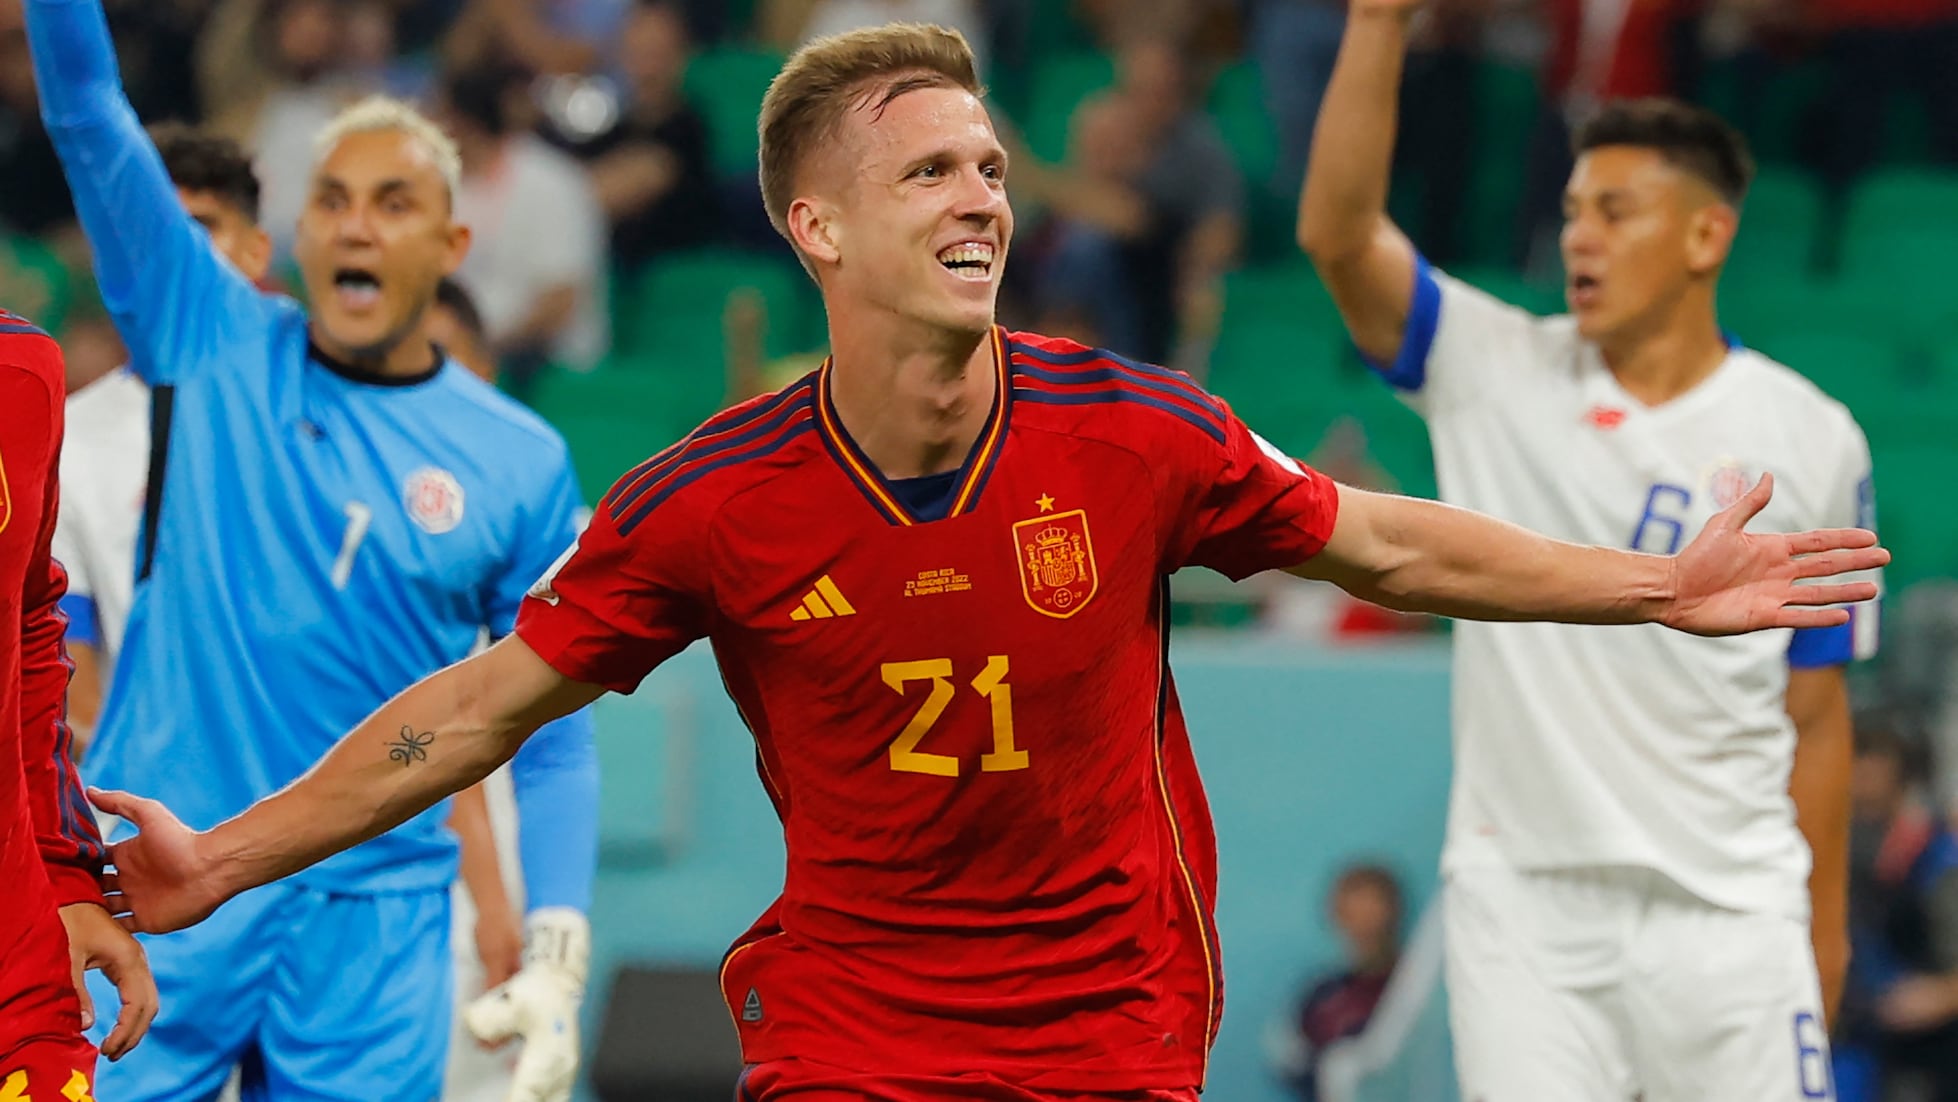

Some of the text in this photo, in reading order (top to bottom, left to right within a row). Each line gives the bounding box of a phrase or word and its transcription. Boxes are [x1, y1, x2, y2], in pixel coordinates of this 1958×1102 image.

[1630, 483, 1692, 556] 6
[880, 655, 1029, 777] 21
[1794, 1013, 1836, 1098] 6
